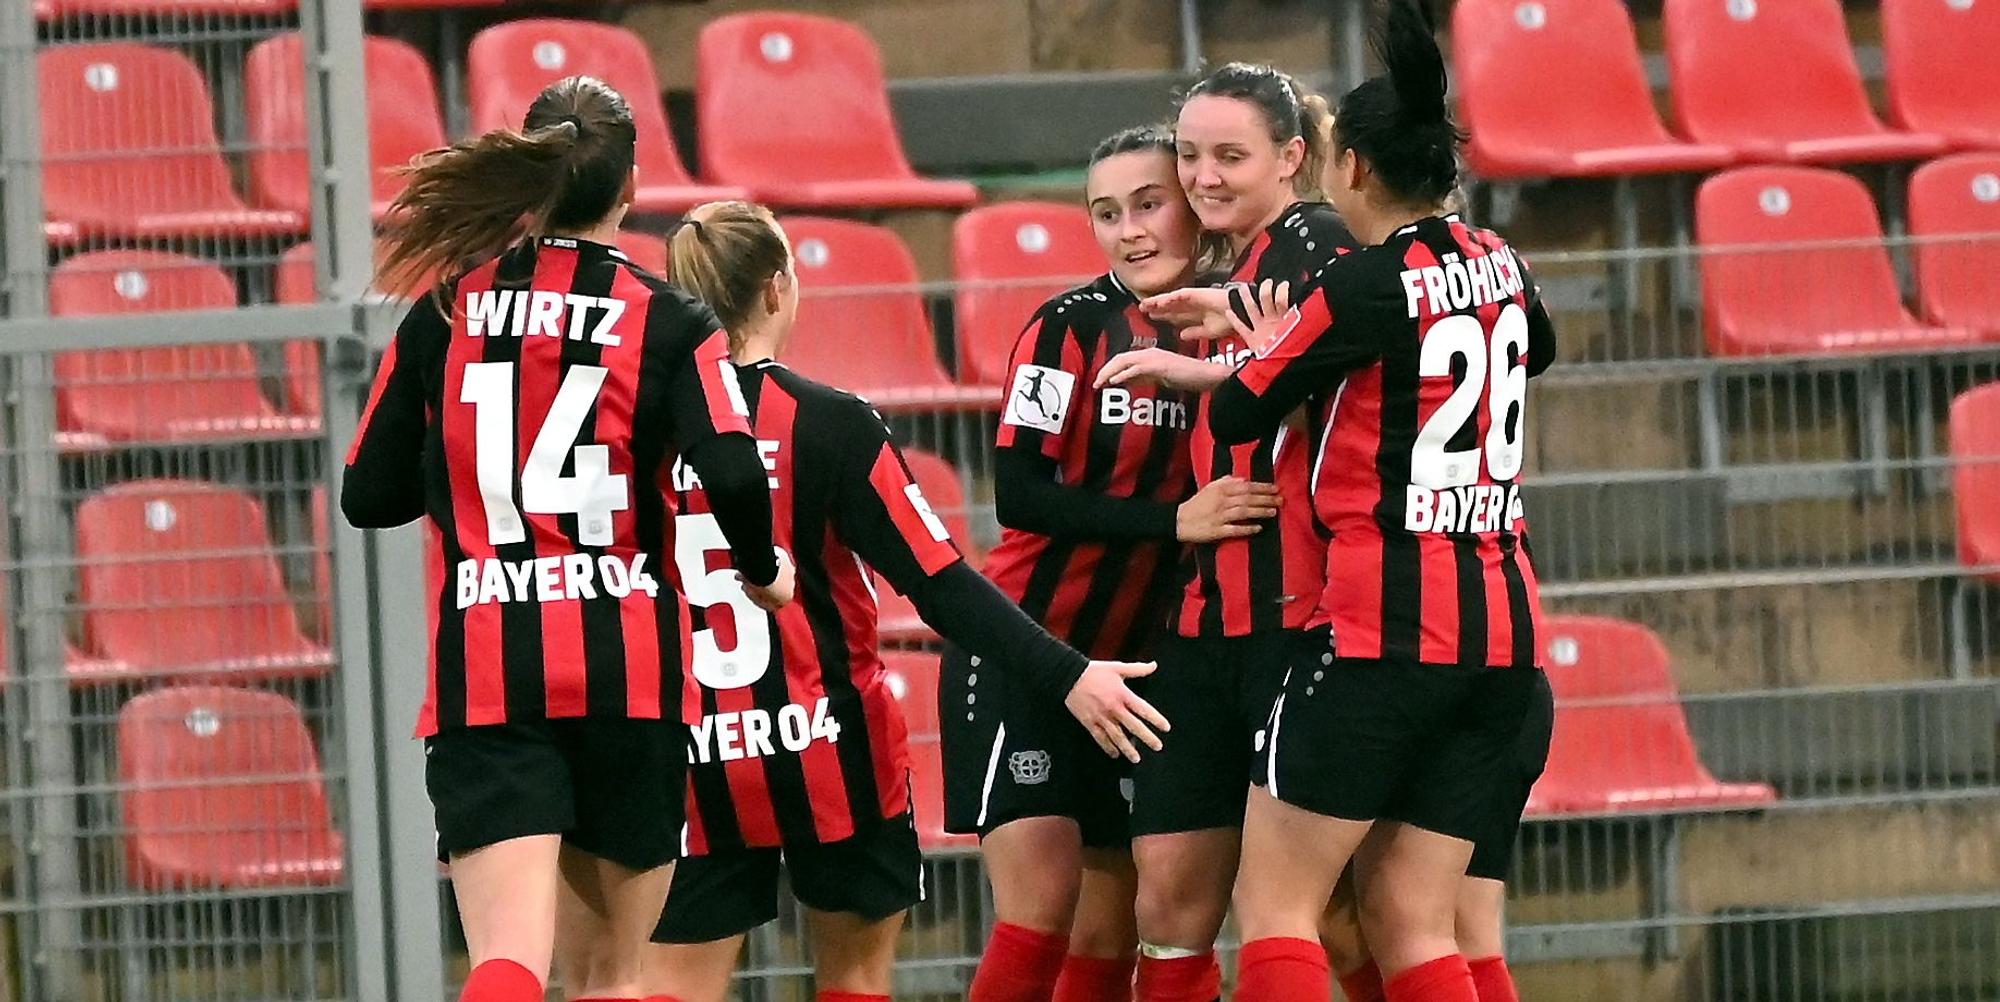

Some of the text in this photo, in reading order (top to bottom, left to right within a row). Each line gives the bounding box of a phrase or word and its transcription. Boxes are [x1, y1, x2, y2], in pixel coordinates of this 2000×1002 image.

[466, 290, 627, 347] WIRTZ
[1411, 303, 1529, 490] 26
[460, 361, 628, 546] 14
[1405, 484, 1504, 533] BAYER
[456, 553, 659, 610] BAYER 04
[674, 513, 771, 689] 5
[687, 697, 841, 764] YER 04
